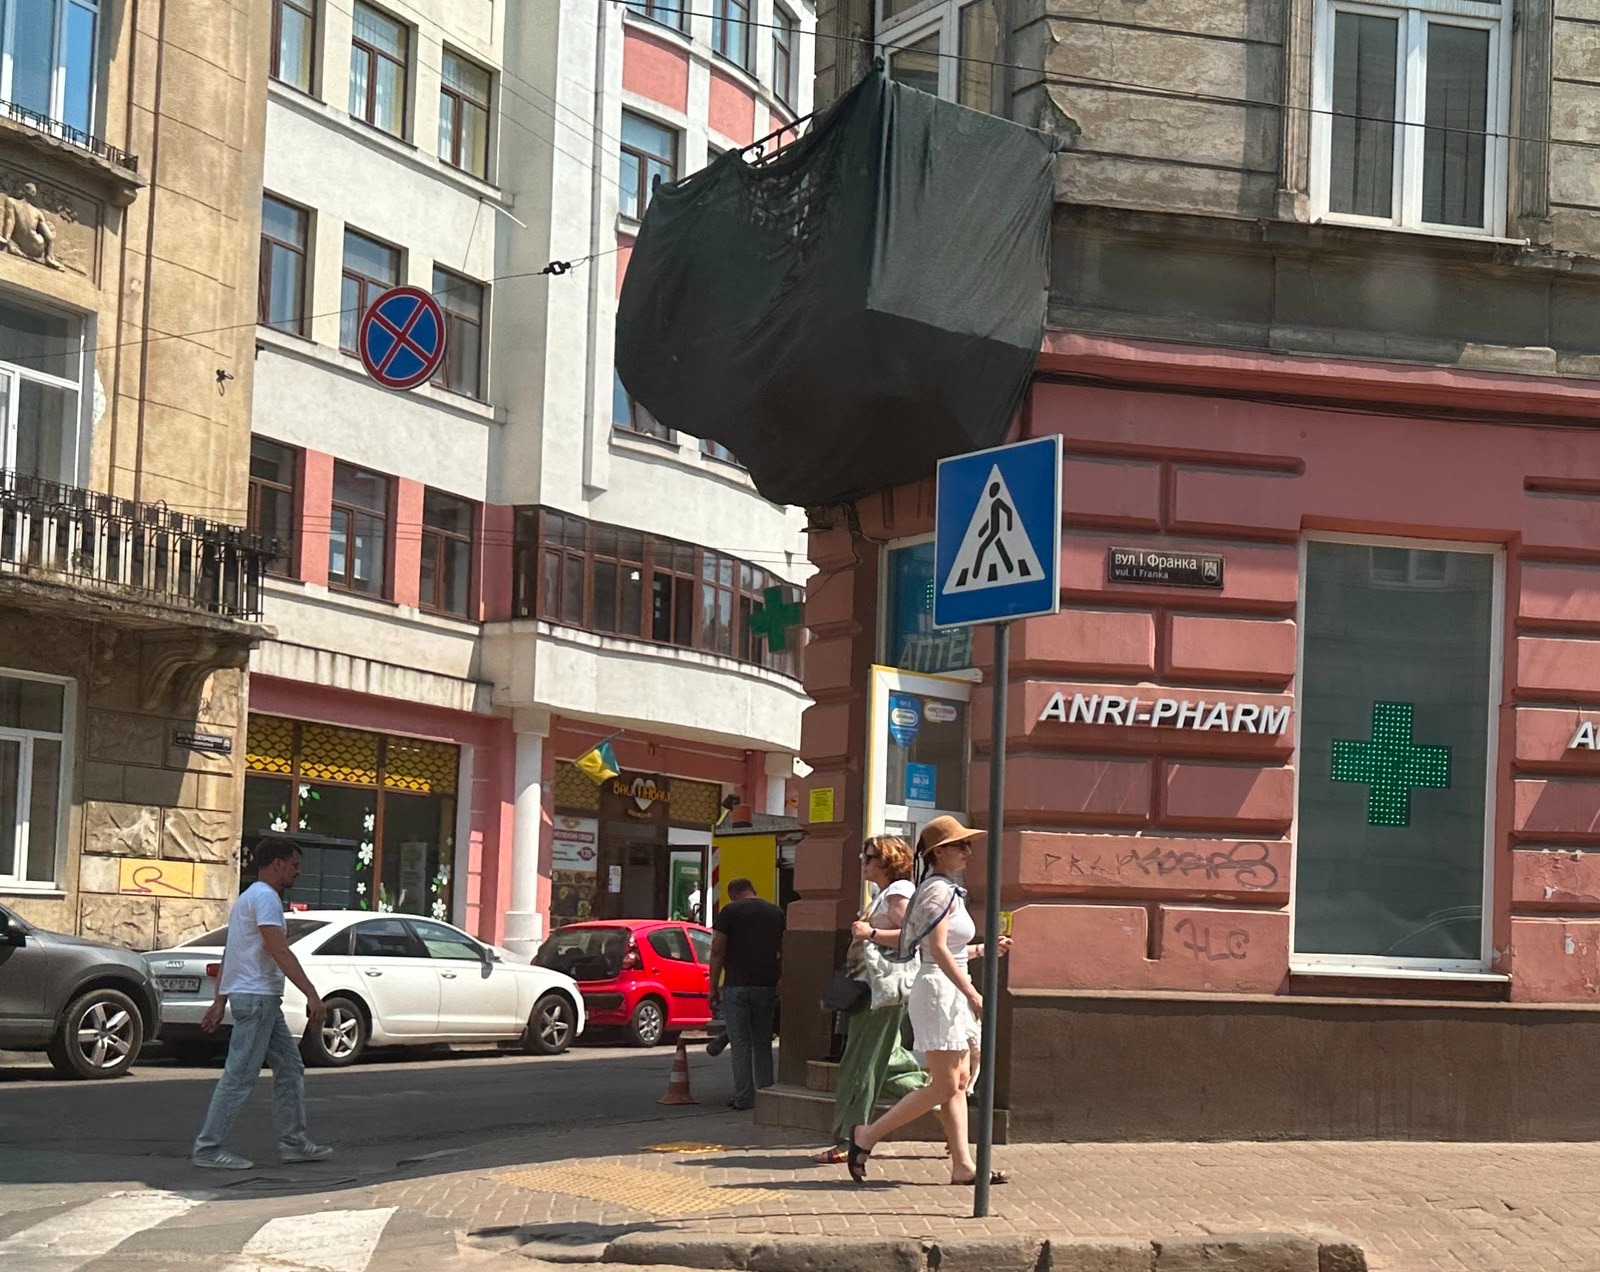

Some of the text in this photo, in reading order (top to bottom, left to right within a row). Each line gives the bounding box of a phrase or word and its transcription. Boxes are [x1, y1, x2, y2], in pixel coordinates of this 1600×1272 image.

[1147, 553, 1197, 570] Франка
[1139, 568, 1169, 579] Franka
[1038, 691, 1291, 735] ANRI-PHARM
